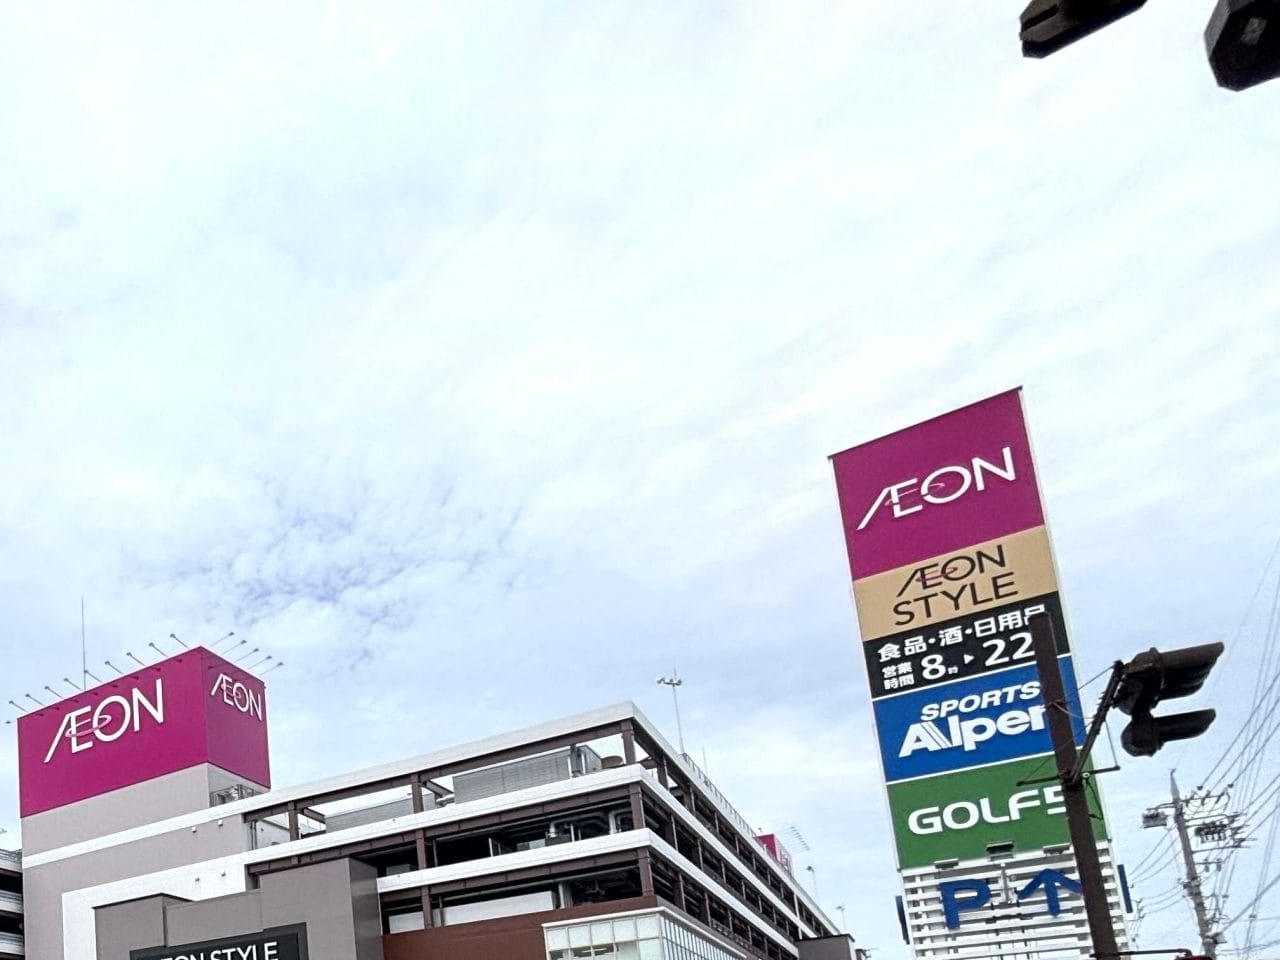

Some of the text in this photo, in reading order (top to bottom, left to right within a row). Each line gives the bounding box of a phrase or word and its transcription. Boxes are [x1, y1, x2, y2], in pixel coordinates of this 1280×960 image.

[893, 572, 1018, 626] STYLE
[921, 681, 1040, 720] SPORTS
[940, 879, 991, 929] P
